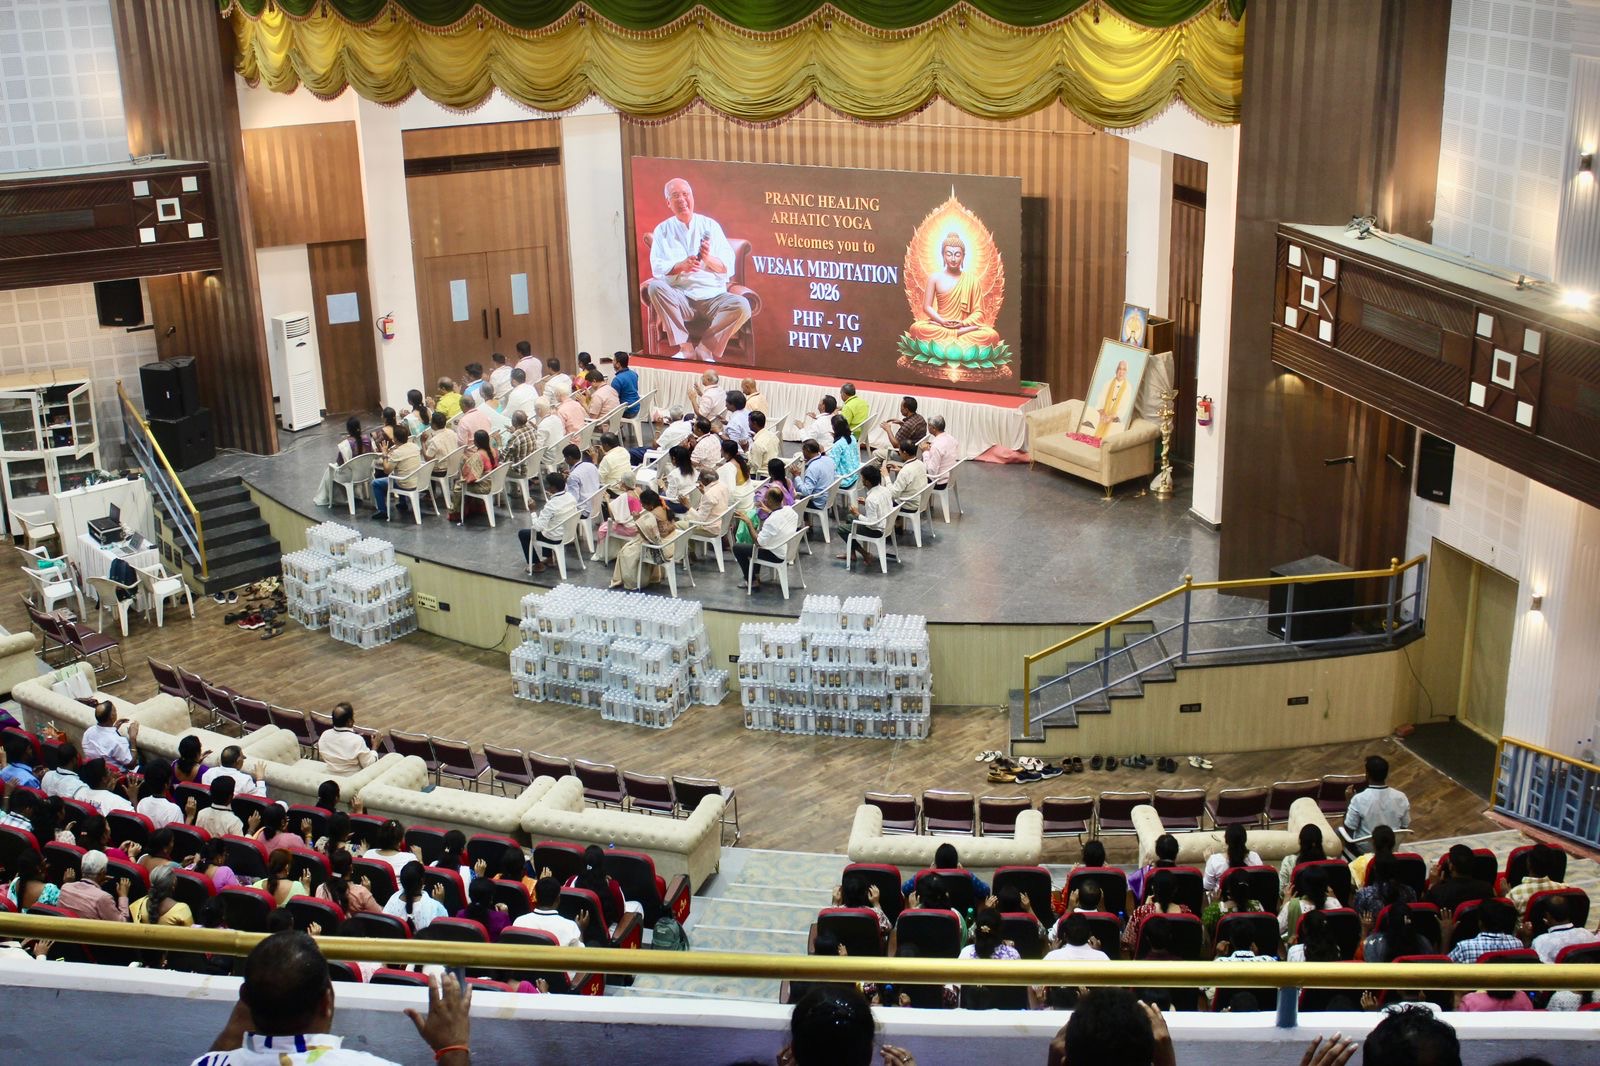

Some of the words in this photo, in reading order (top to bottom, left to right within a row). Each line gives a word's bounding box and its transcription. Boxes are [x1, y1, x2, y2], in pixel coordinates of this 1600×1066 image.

[765, 191, 814, 208] PRANIC
[818, 195, 880, 211] HEALING
[771, 211, 830, 227] ARHATIC
[833, 215, 872, 230] YOGA
[774, 232, 834, 250] Welcomes
[837, 241, 859, 254] you
[863, 239, 875, 253] to
[752, 255, 804, 277] WESAK
[807, 260, 897, 284] MEDITATION
[810, 282, 840, 301] 2026
[793, 309, 824, 328] PHF
[836, 313, 860, 331] TG
[789, 330, 832, 350] PHTV
